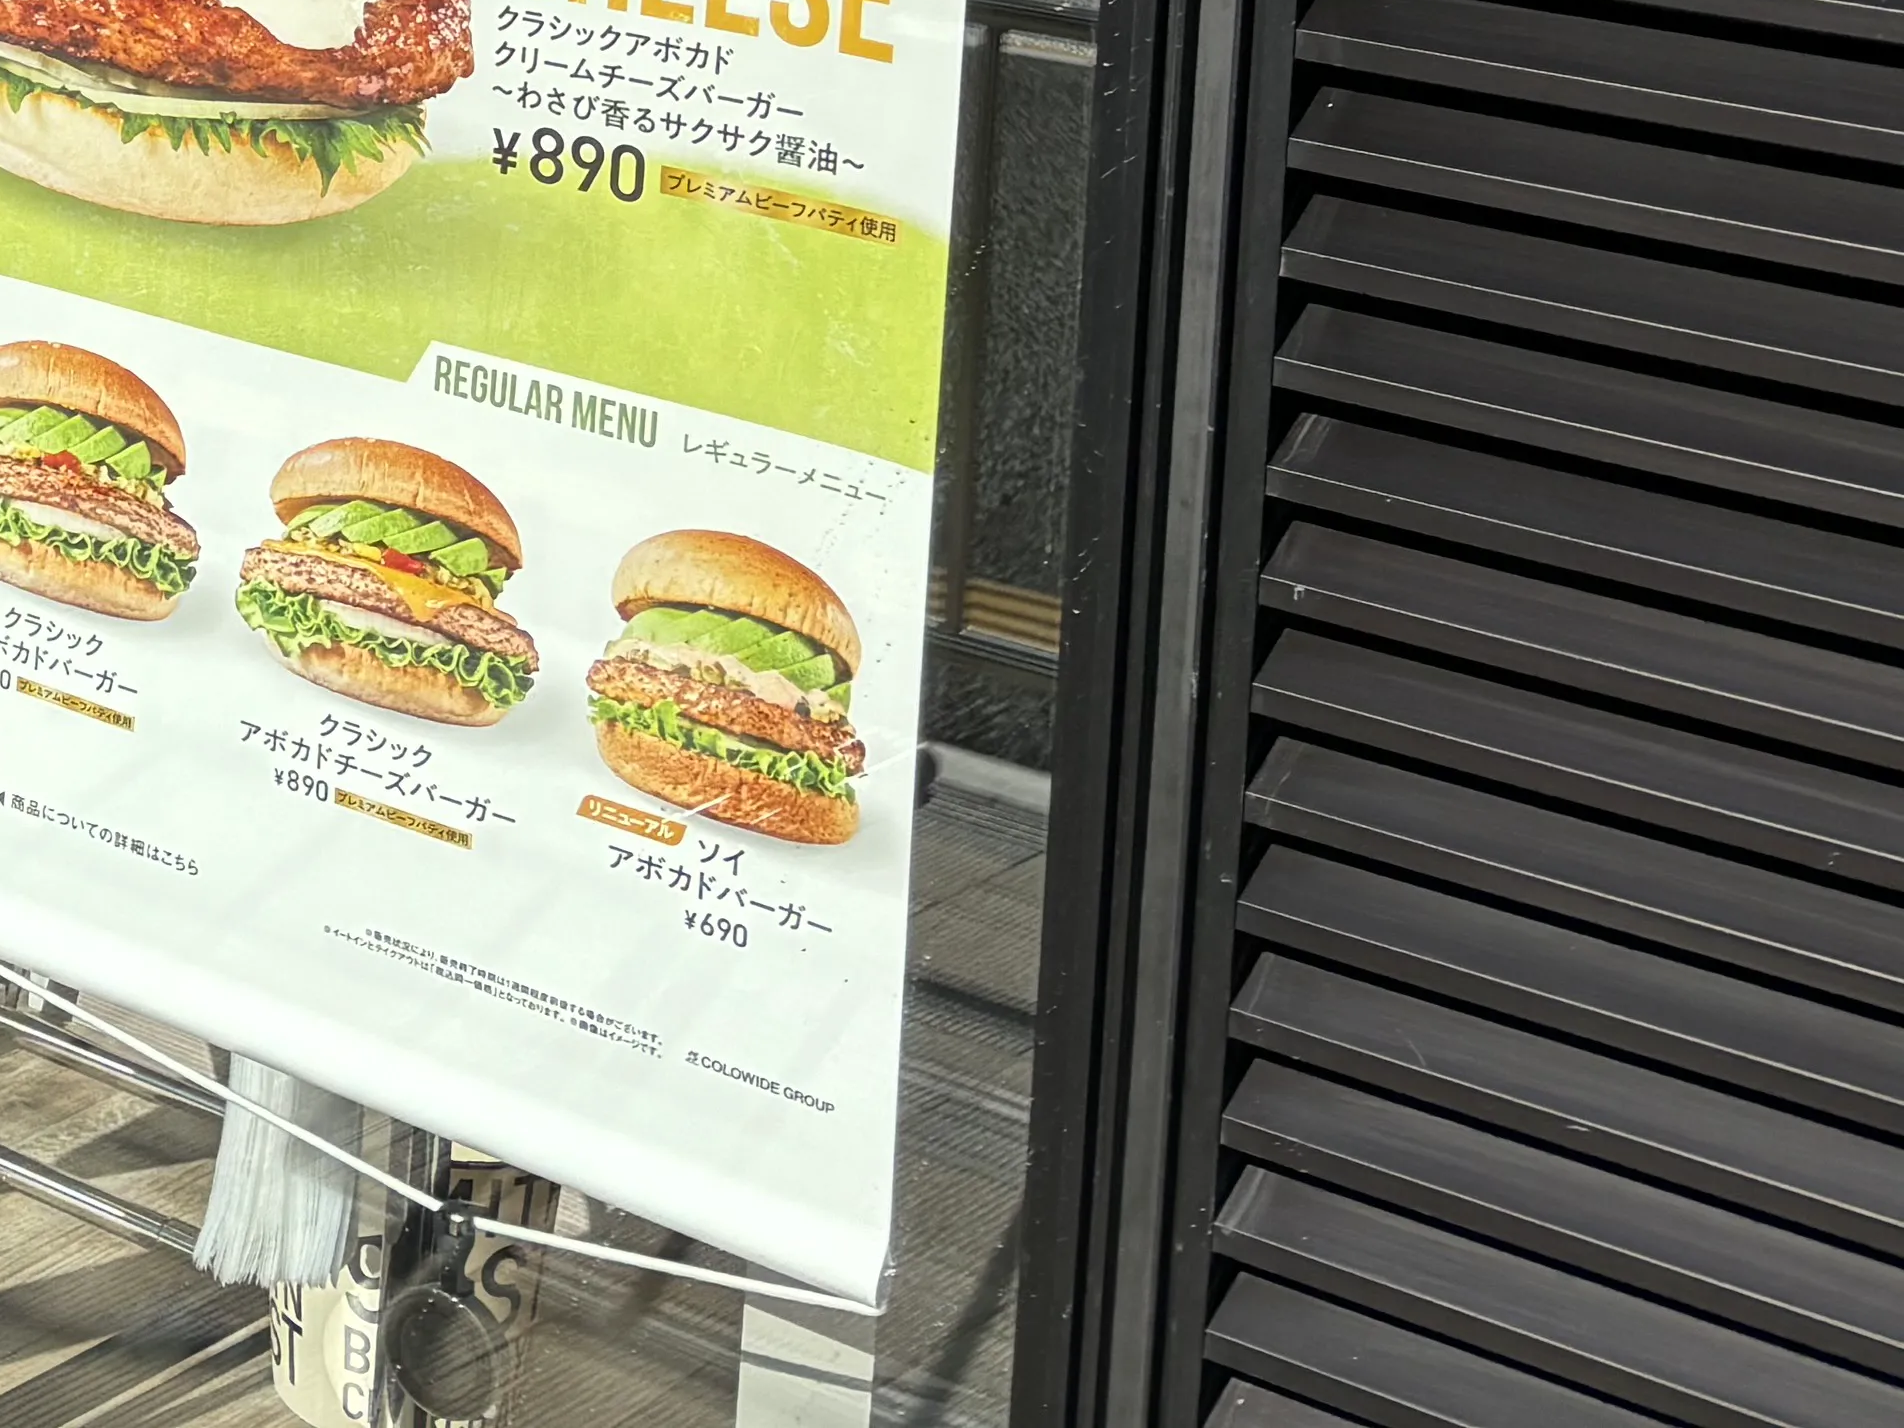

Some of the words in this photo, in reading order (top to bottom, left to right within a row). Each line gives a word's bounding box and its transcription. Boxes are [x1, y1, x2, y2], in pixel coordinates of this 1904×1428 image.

[497, 5, 735, 76] クラシックアボカド
[494, 42, 806, 121] クリームチーズバーガー
[492, 126, 647, 204] ¥890
[667, 172, 898, 244] プレミアムビーフパティ使用
[434, 354, 563, 424] REGULAR
[572, 390, 659, 448] MENU
[683, 432, 888, 502] レギュラーメニュー
[4, 606, 104, 656] クラシック
[239, 719, 517, 824] アボカドチーズバーガー
[319, 713, 434, 767] クラシック
[273, 767, 330, 802] ¥890
[586, 798, 676, 841] リニューアル
[10, 793, 199, 876] 商品についての詳細はこちら
[698, 839, 748, 876] ソイ
[608, 844, 834, 934] アボカドバーガー
[683, 909, 749, 950] ¥690
[701, 1055, 781, 1095] COLOWIDE
[783, 1086, 836, 1114] GROUP
